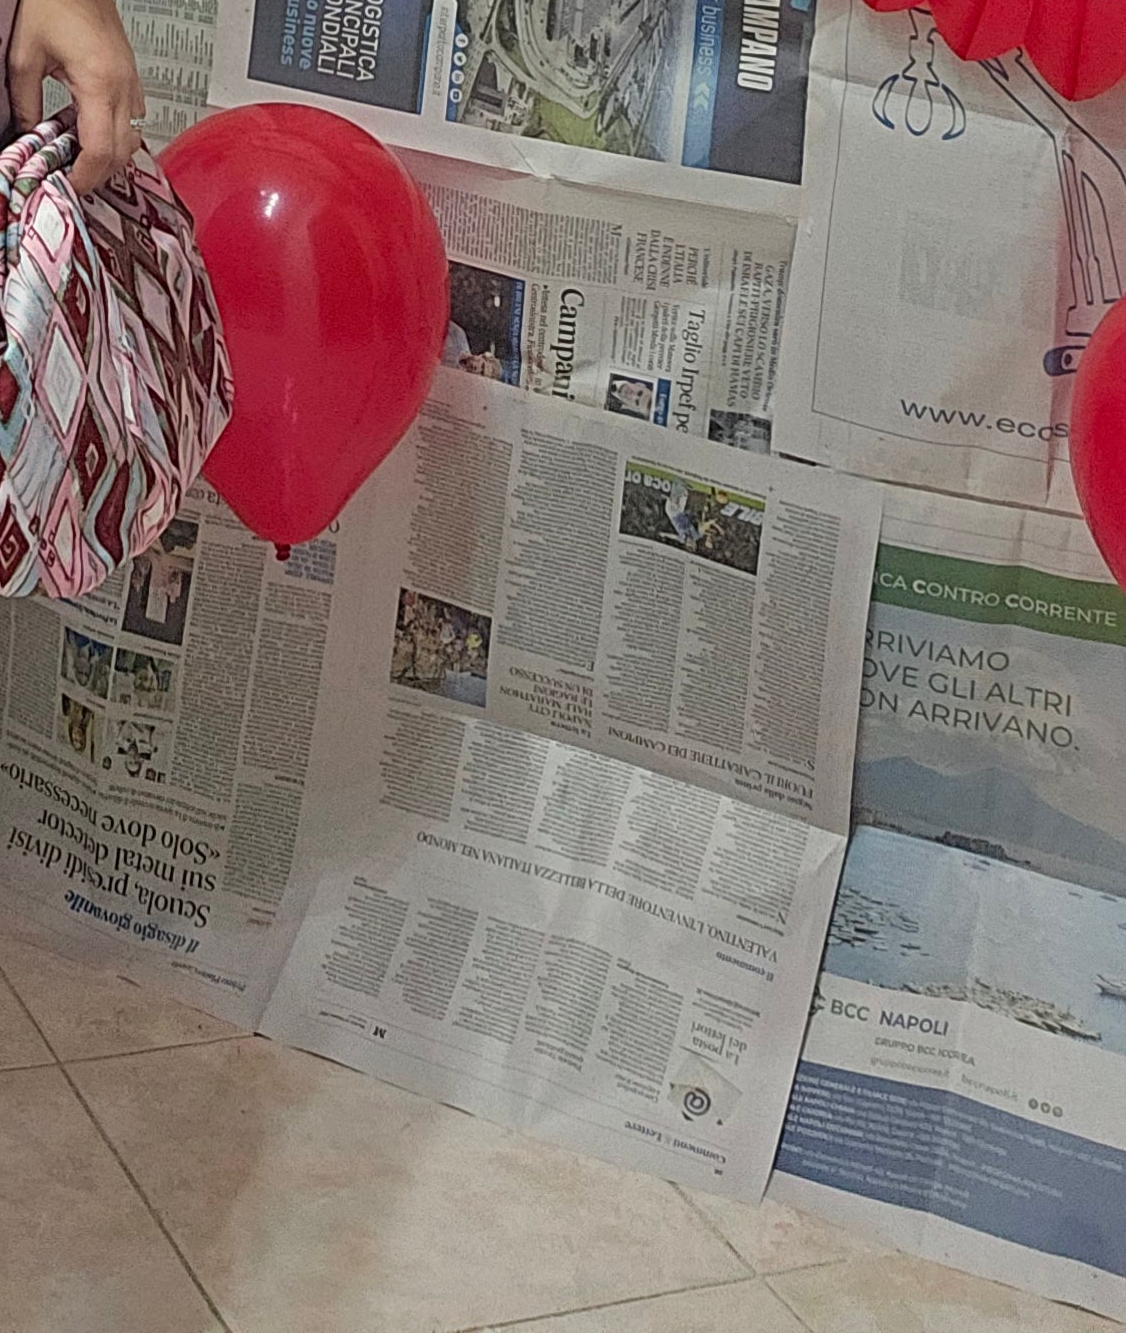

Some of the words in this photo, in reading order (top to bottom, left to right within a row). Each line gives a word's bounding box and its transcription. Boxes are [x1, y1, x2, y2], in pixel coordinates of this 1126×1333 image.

[299, 9, 320, 70] nuove
[697, 6, 722, 77] business
[549, 288, 585, 402] Campani
[682, 310, 707, 364] Taglio
[677, 366, 700, 412] Irpef
[912, 580, 999, 607] CONTRO
[1005, 594, 1118, 627] CORRENTE
[864, 630, 1010, 672] RRIVIAMO
[862, 657, 918, 688] OVE
[928, 673, 974, 700] GLI
[985, 682, 1072, 717] ALTRI
[859, 687, 898, 713] ON
[908, 699, 1080, 752] ARRIVANO.
[0, 762, 98, 825] necessario»
[7, 827, 62, 869] divisi
[38, 809, 109, 865] detector
[101, 814, 157, 848] dove
[161, 830, 220, 866] «Solo
[414, 829, 460, 855] MONDO
[456, 841, 481, 860] NEL
[63, 851, 130, 896] presidi
[114, 847, 175, 882] metal
[180, 868, 217, 892] sui
[479, 848, 533, 875] ITALIANA
[532, 864, 587, 889] BELLEZZA
[64, 889, 133, 932] giovanile
[134, 884, 211, 928] Scuola,
[586, 878, 627, 902] DELLA
[625, 890, 705, 937] L'INVENTORE
[133, 921, 187, 950] disagio
[705, 926, 780, 963] VALENTINO,
[830, 999, 870, 1022] BCC
[879, 1010, 949, 1037] NAPOLI
